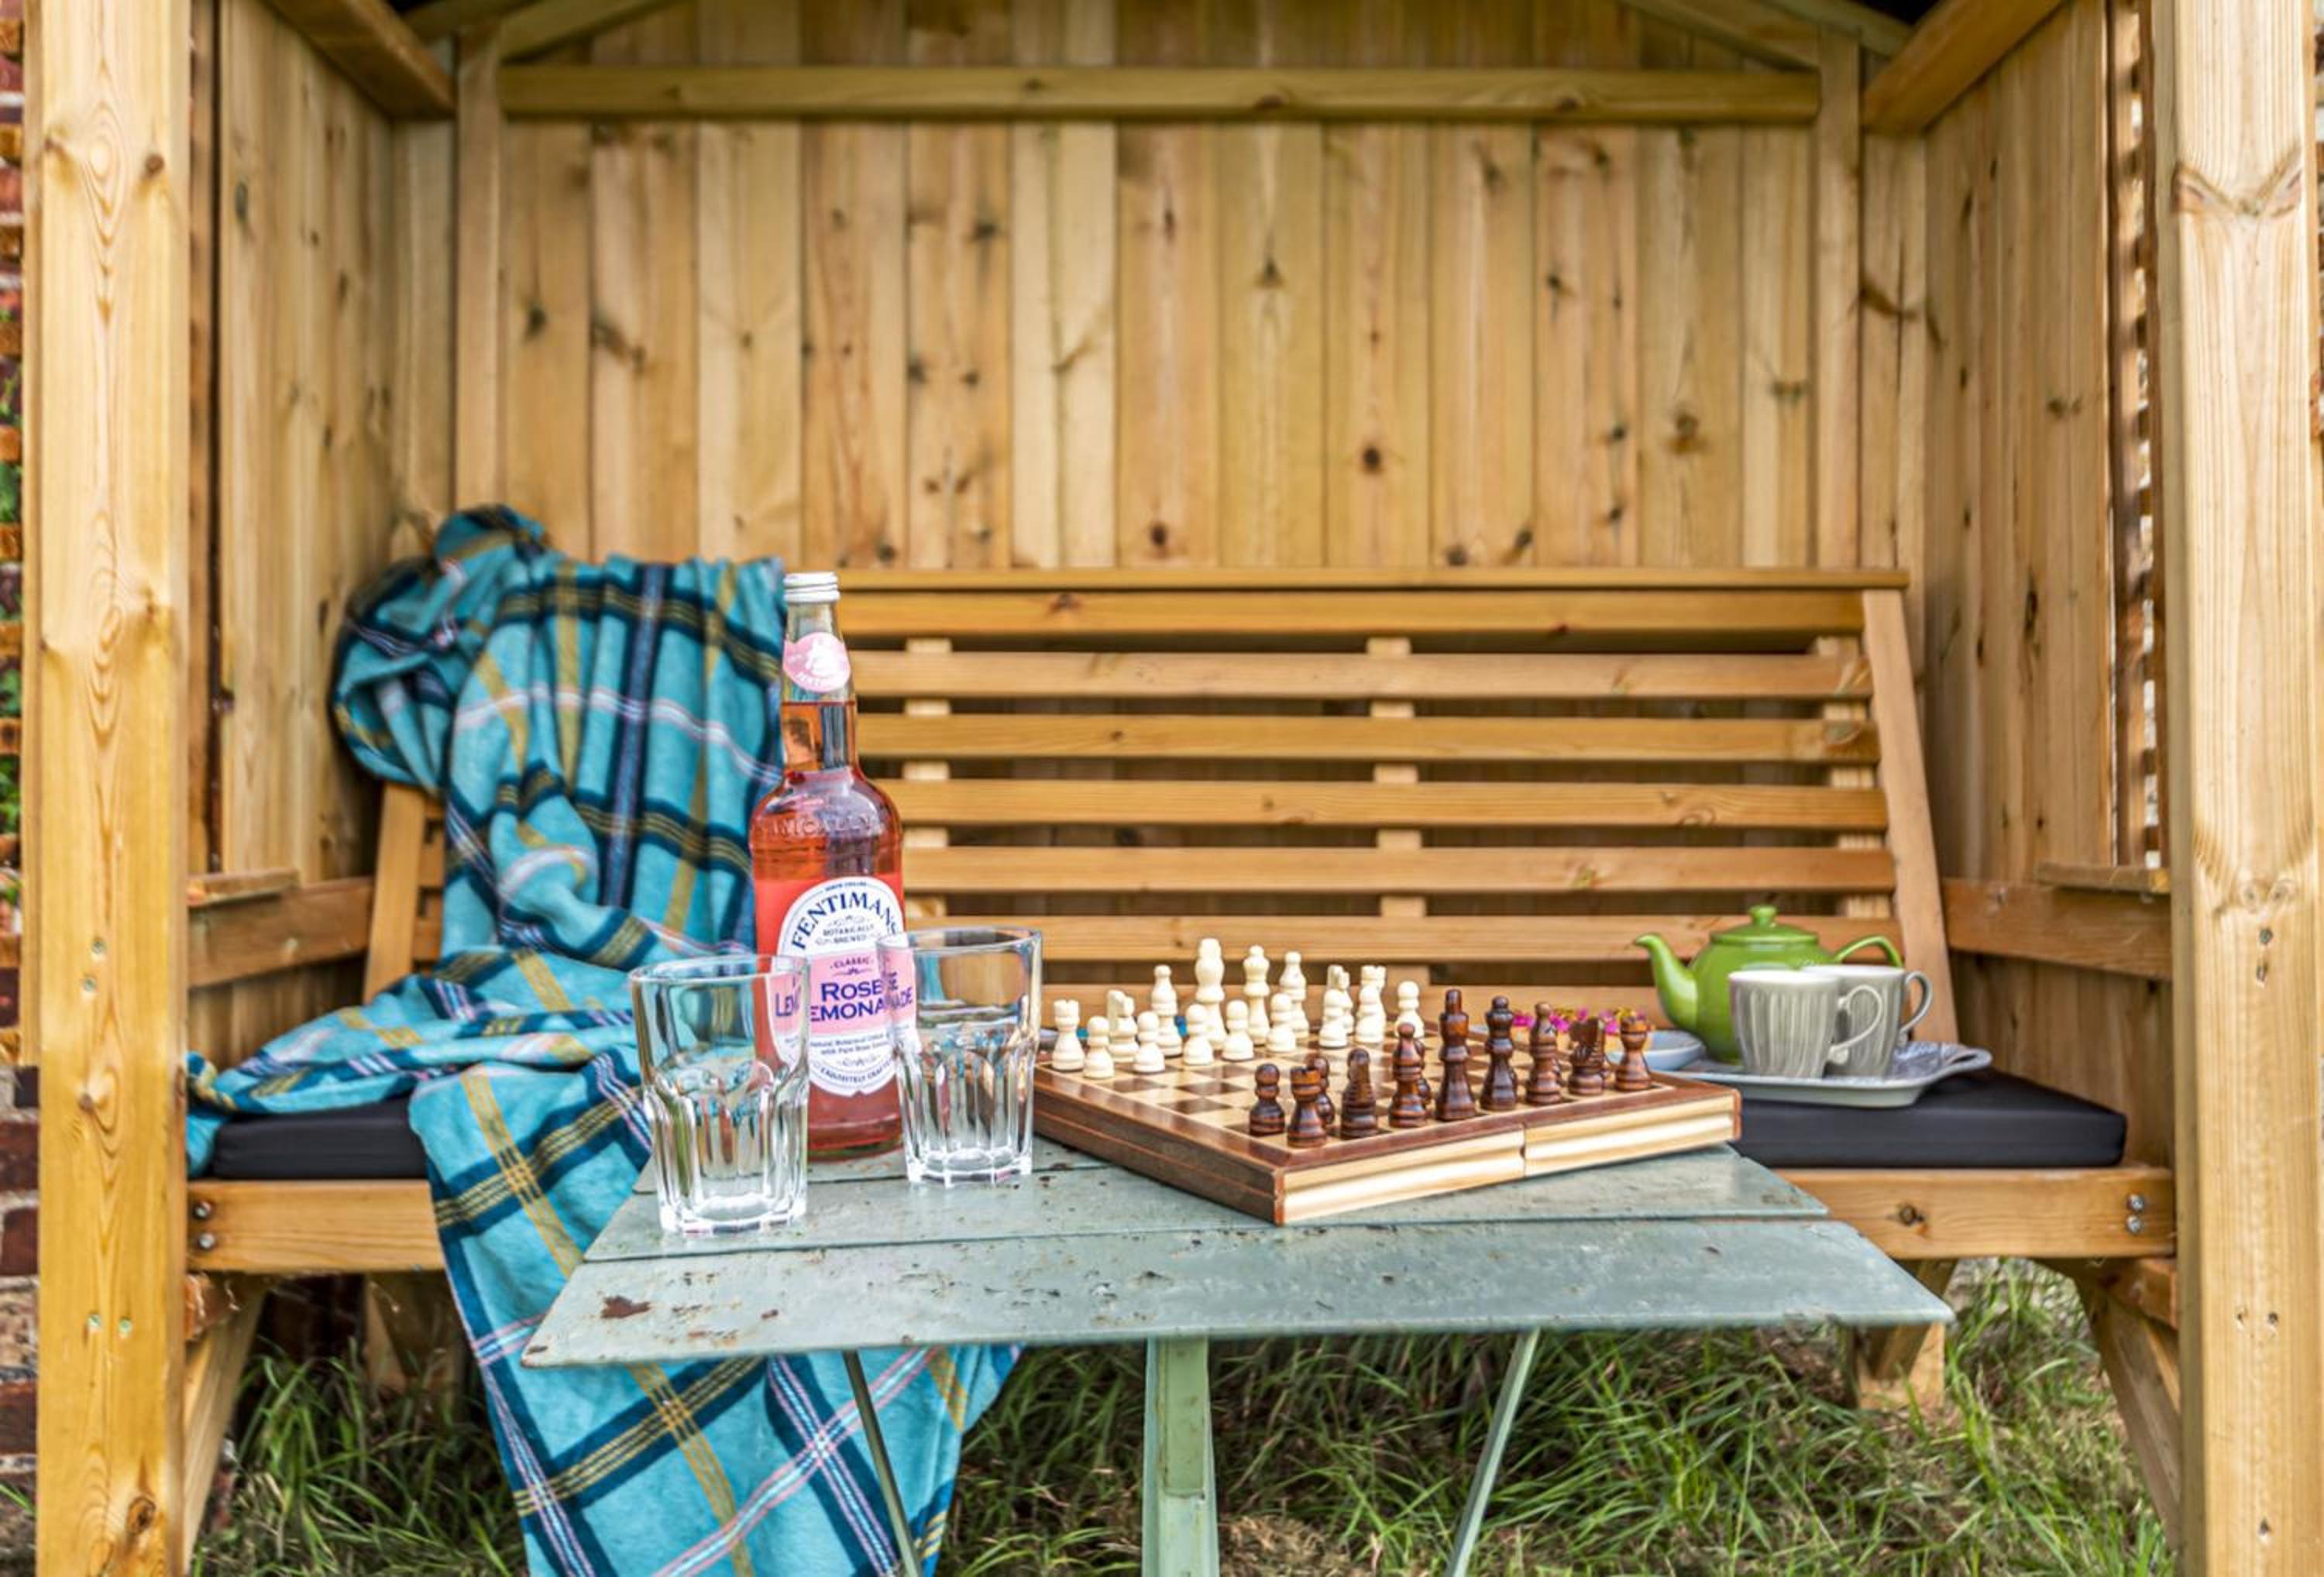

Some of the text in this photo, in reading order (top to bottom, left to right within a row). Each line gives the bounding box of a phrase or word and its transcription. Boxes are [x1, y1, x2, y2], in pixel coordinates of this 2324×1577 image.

[791, 891, 898, 950] FENTIMANS
[823, 924, 875, 936] BOTANICALLY
[834, 955, 871, 968] CLASSIC
[821, 978, 885, 1003] ROSE
